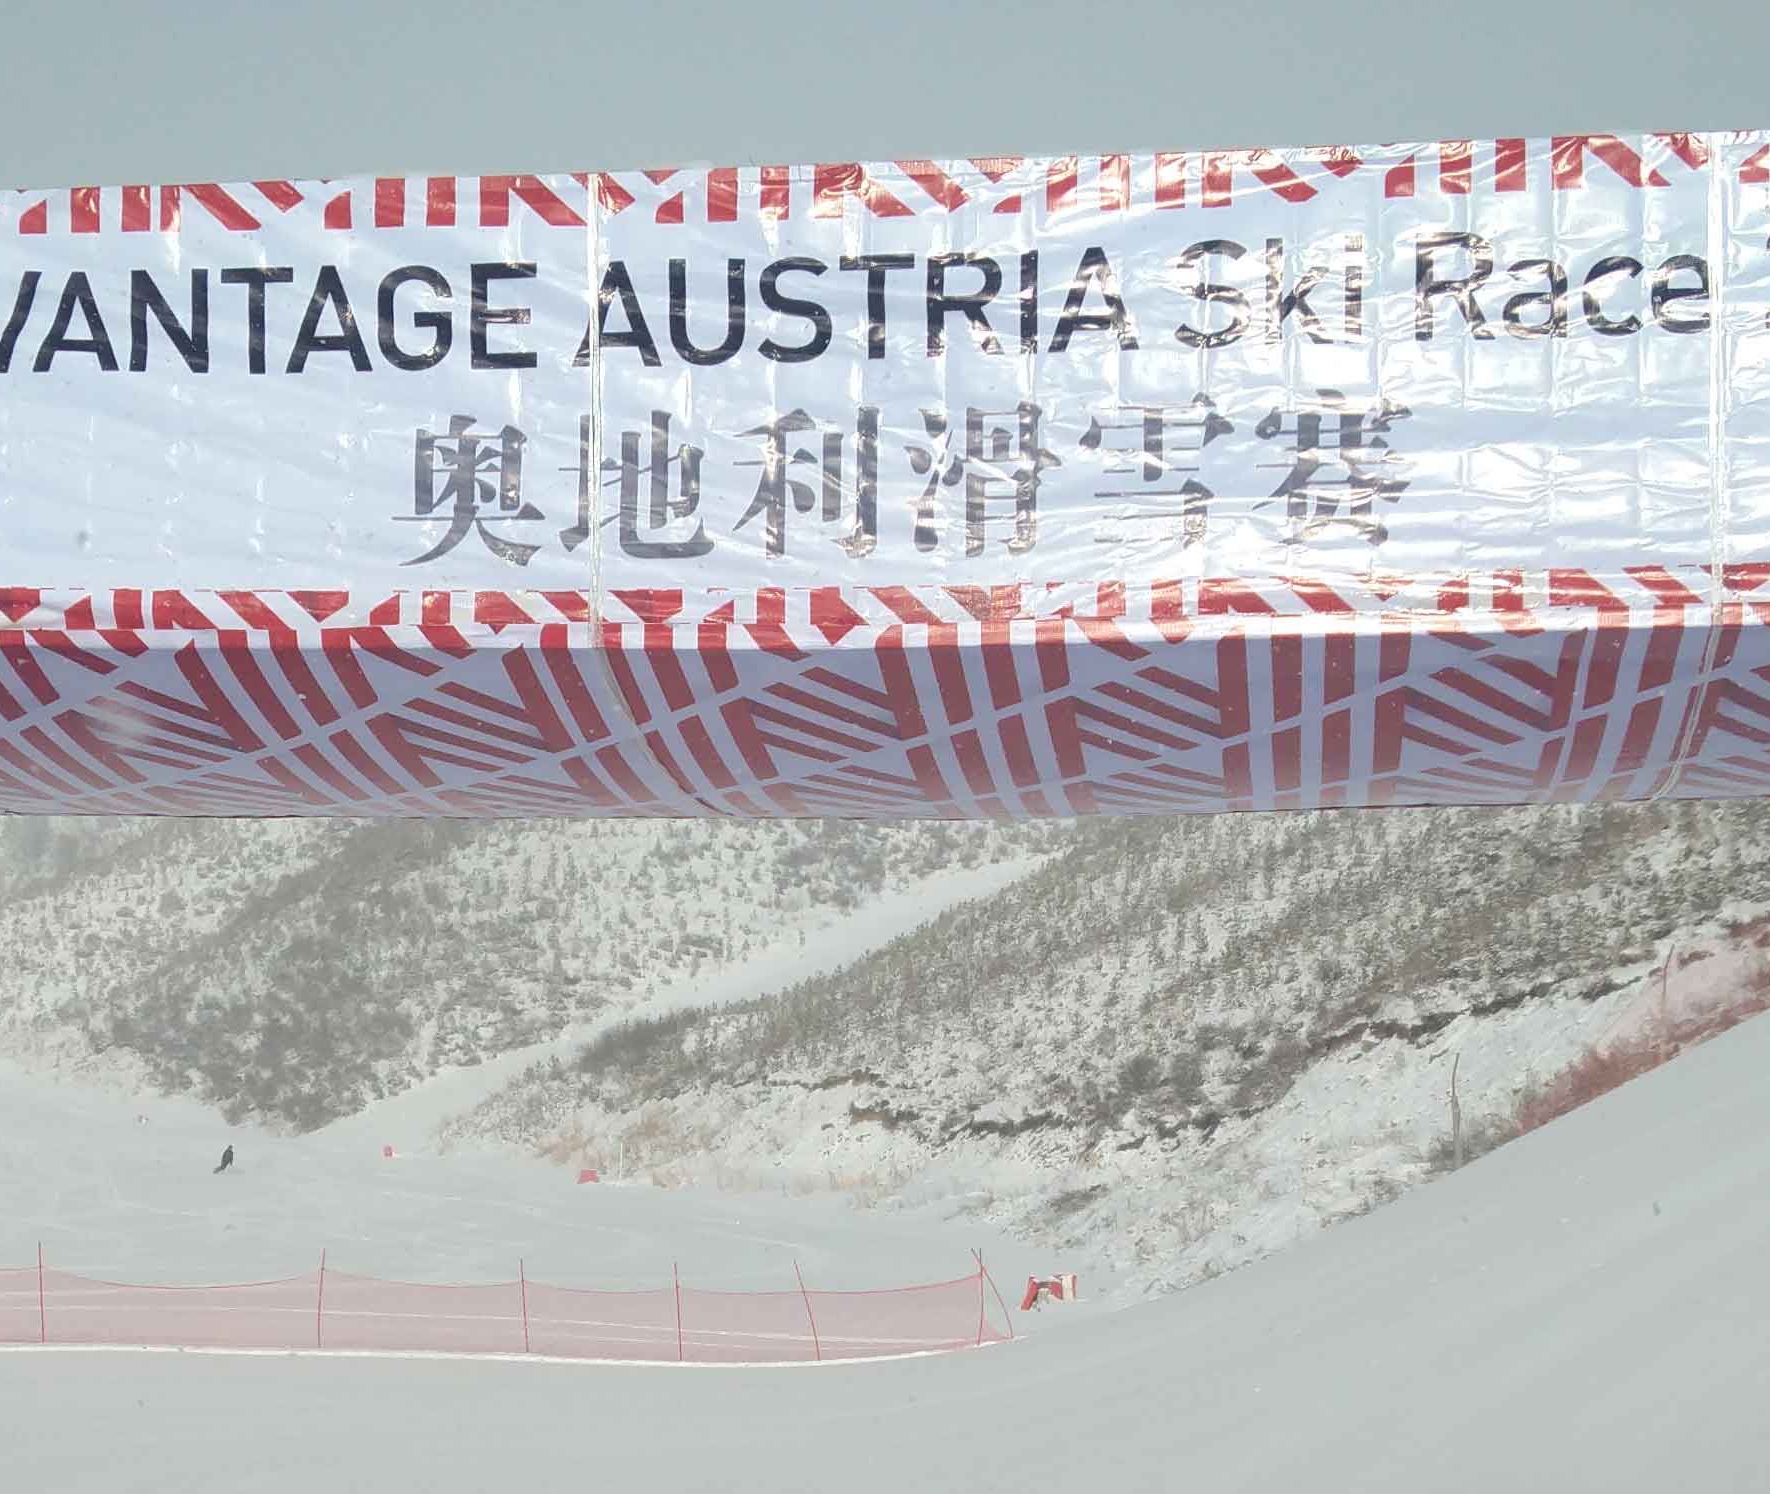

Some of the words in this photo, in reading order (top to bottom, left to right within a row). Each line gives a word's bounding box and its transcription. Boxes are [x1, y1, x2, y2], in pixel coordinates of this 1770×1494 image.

[572, 247, 1140, 367] AUSTRIA
[1174, 233, 1364, 349] Ski
[1414, 231, 1711, 342] Race
[391, 389, 1413, 567] 奥地利滑雪赛
